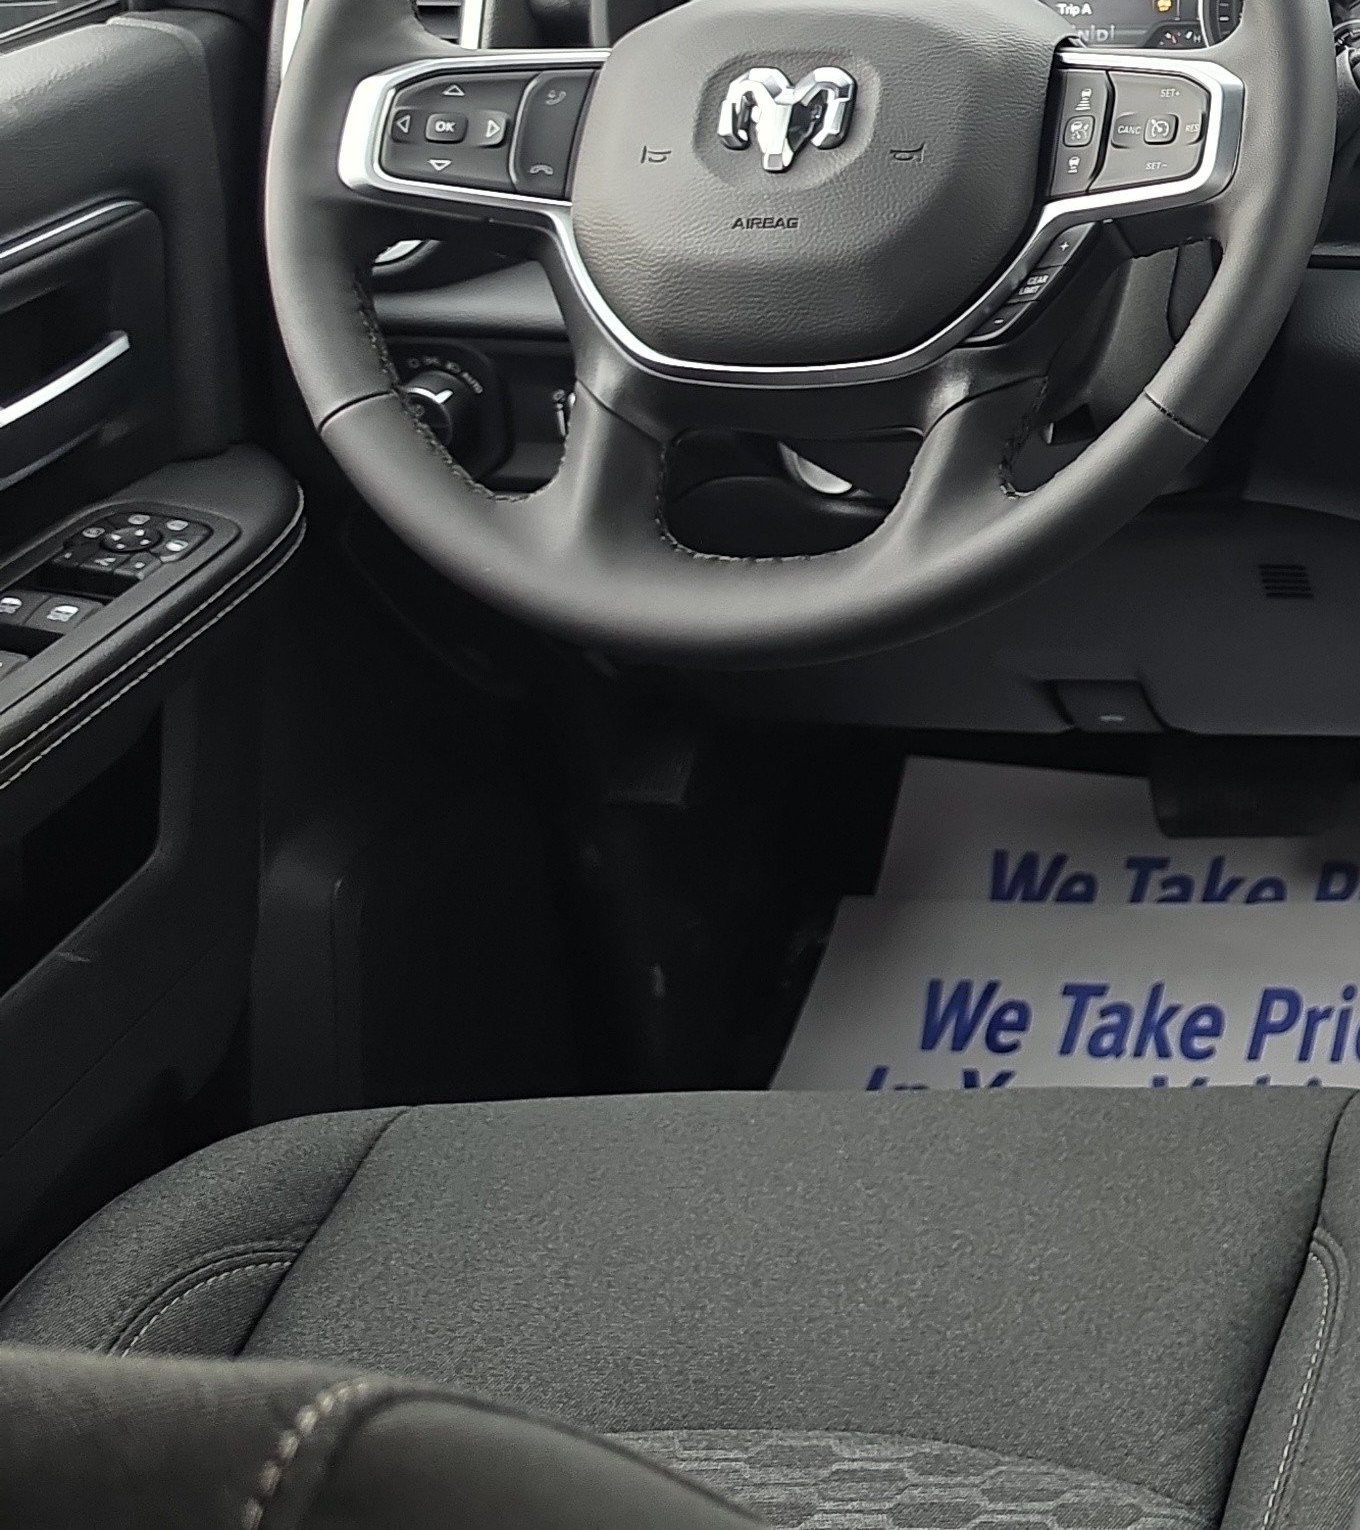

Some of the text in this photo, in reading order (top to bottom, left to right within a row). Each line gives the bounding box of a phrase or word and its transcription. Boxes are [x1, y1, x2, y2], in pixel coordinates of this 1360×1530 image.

[1056, 3, 1093, 17] Trip A
[435, 121, 456, 133] OK
[1117, 125, 1142, 135] CANC
[1184, 122, 1200, 133] RES
[731, 217, 799, 230] AIRBAG
[1026, 274, 1050, 286] GEAR
[990, 849, 1097, 903] We
[1125, 856, 1288, 904] Take
[920, 977, 1031, 1054] We
[1058, 981, 1225, 1062] Take
